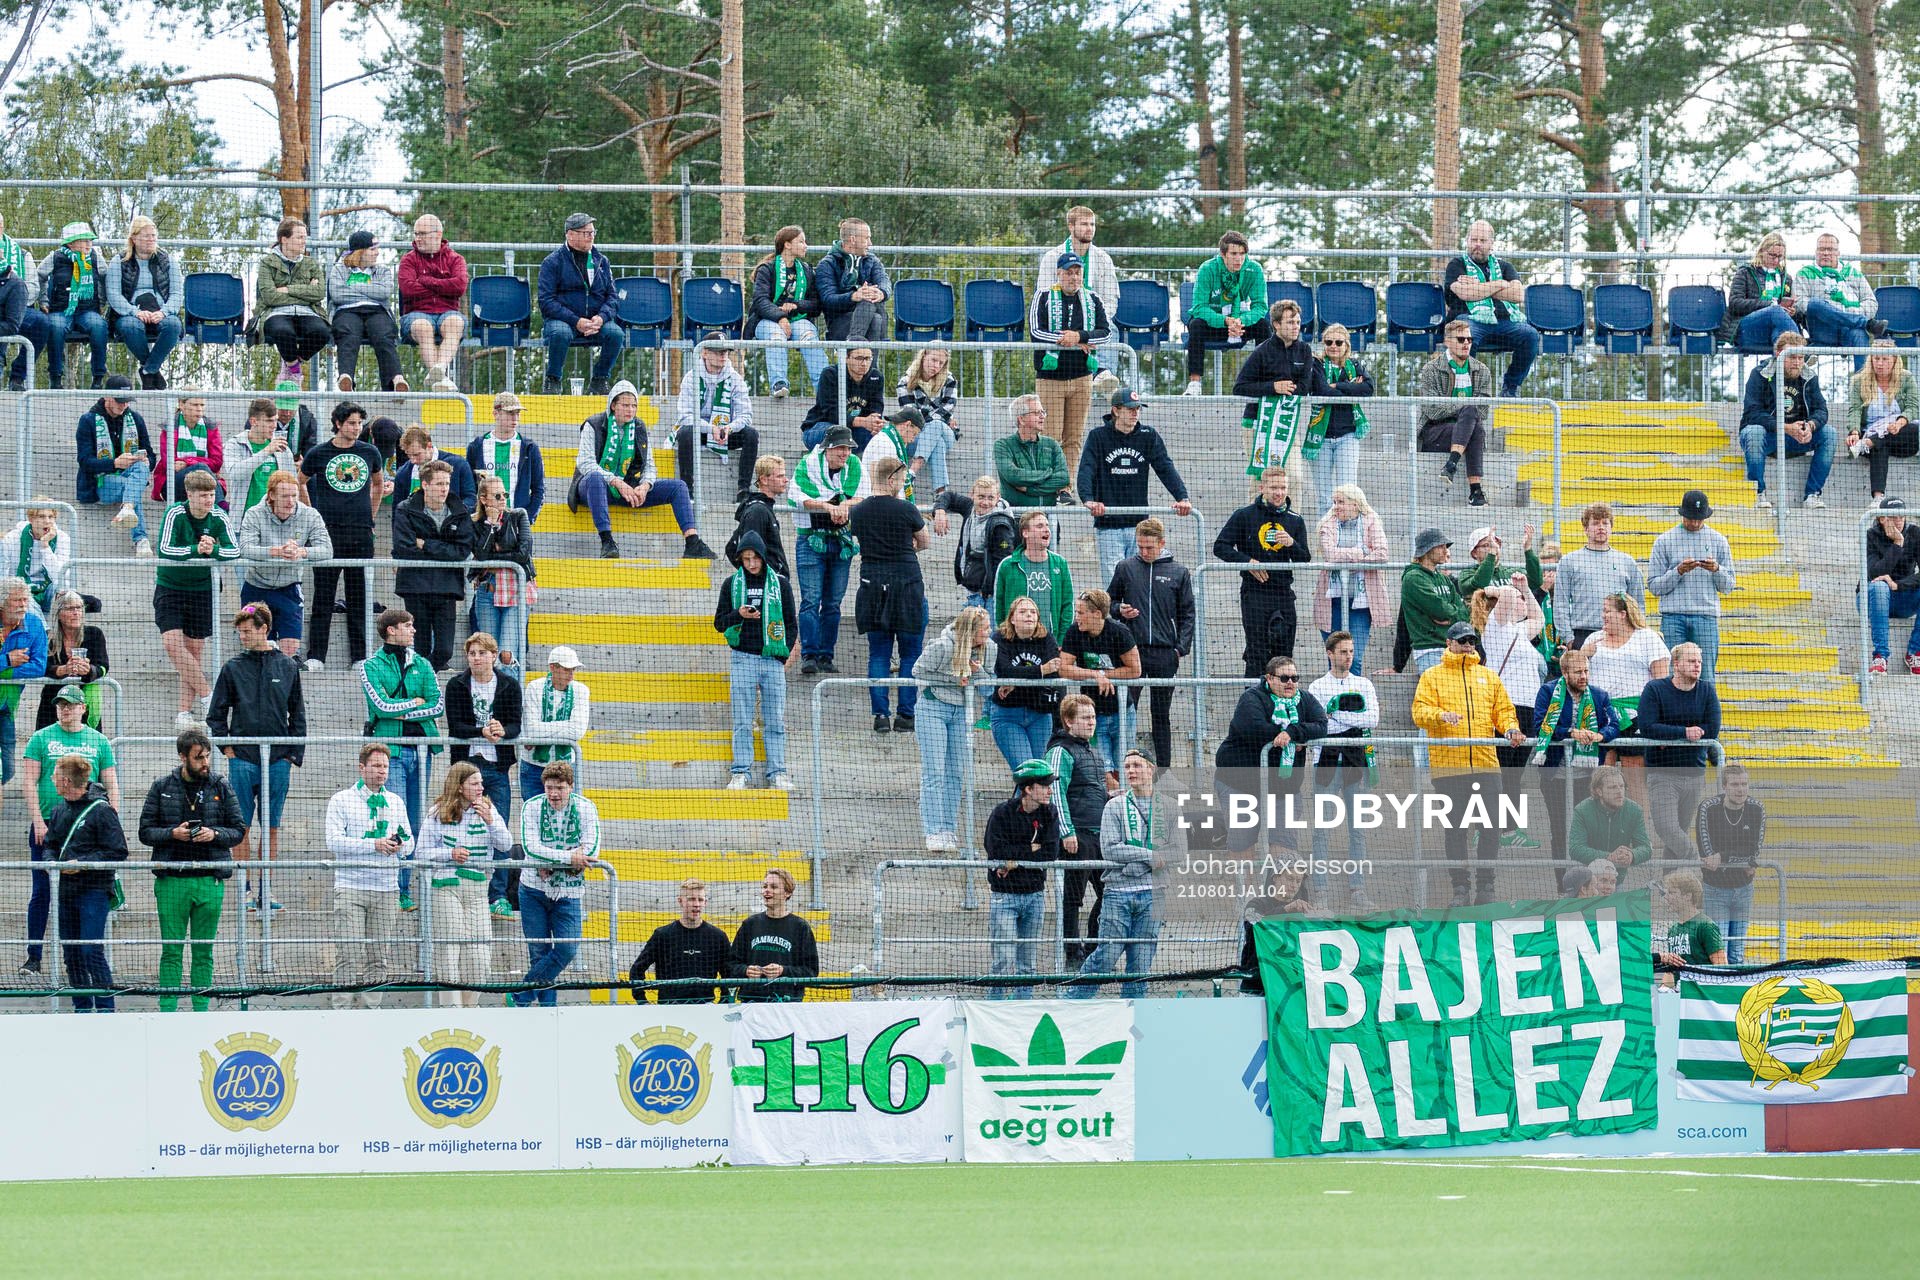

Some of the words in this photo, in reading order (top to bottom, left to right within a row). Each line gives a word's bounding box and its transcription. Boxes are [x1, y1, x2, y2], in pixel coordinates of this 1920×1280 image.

[328, 455, 368, 472] HAMMARBY
[1105, 447, 1140, 463] HAMMARBY
[328, 473, 368, 490] STOCKHOLM
[751, 935, 792, 952] HAMMARBY
[1298, 907, 1624, 1029] BAJEN
[751, 1017, 930, 1115] 116
[217, 1064, 280, 1099] HSB
[420, 1061, 483, 1096] HSB
[632, 1058, 695, 1093] HSB
[1320, 1020, 1634, 1142] ALLEZ
[979, 1118, 1047, 1146] aeg
[1056, 1112, 1115, 1138] out
[1677, 1126, 1747, 1139] sca.com
[159, 1144, 186, 1156] HSB
[200, 1143, 222, 1156] där
[225, 1142, 315, 1158] möjligheterna
[318, 1142, 340, 1154] bor
[363, 1141, 390, 1153] HSB
[403, 1140, 425, 1152] där
[428, 1139, 517, 1154] möjligheterna
[521, 1139, 542, 1151] bor
[575, 1137, 602, 1150] HSB
[616, 1136, 637, 1149] där
[640, 1136, 729, 1151] möjligheterna
